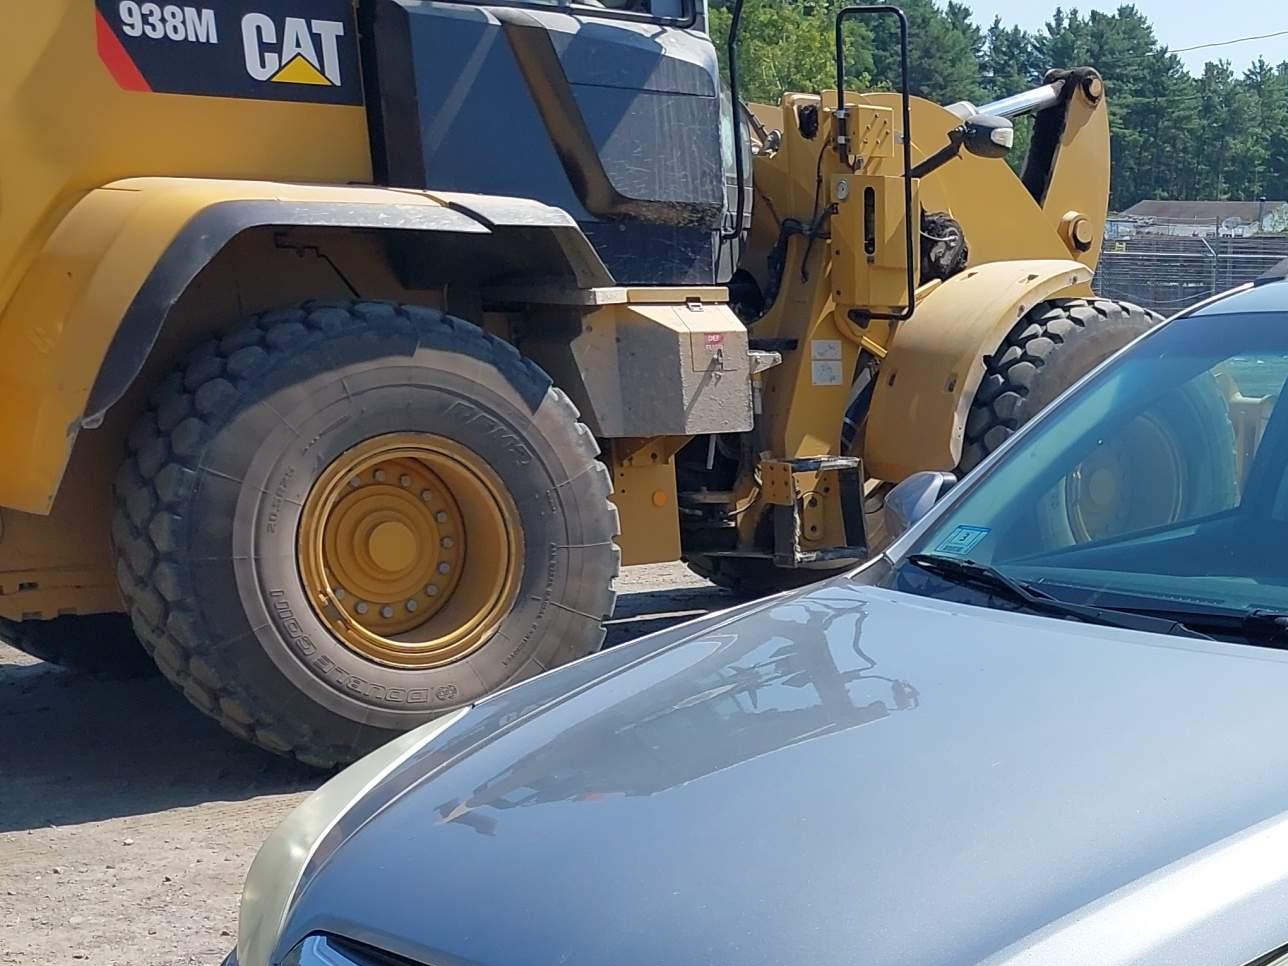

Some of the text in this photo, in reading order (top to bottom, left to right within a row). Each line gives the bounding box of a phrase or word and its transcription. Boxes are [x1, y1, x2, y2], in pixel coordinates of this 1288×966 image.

[118, 0, 218, 44] 938M
[241, 13, 344, 86] CAT
[269, 588, 429, 704] DOUBLE COIN
